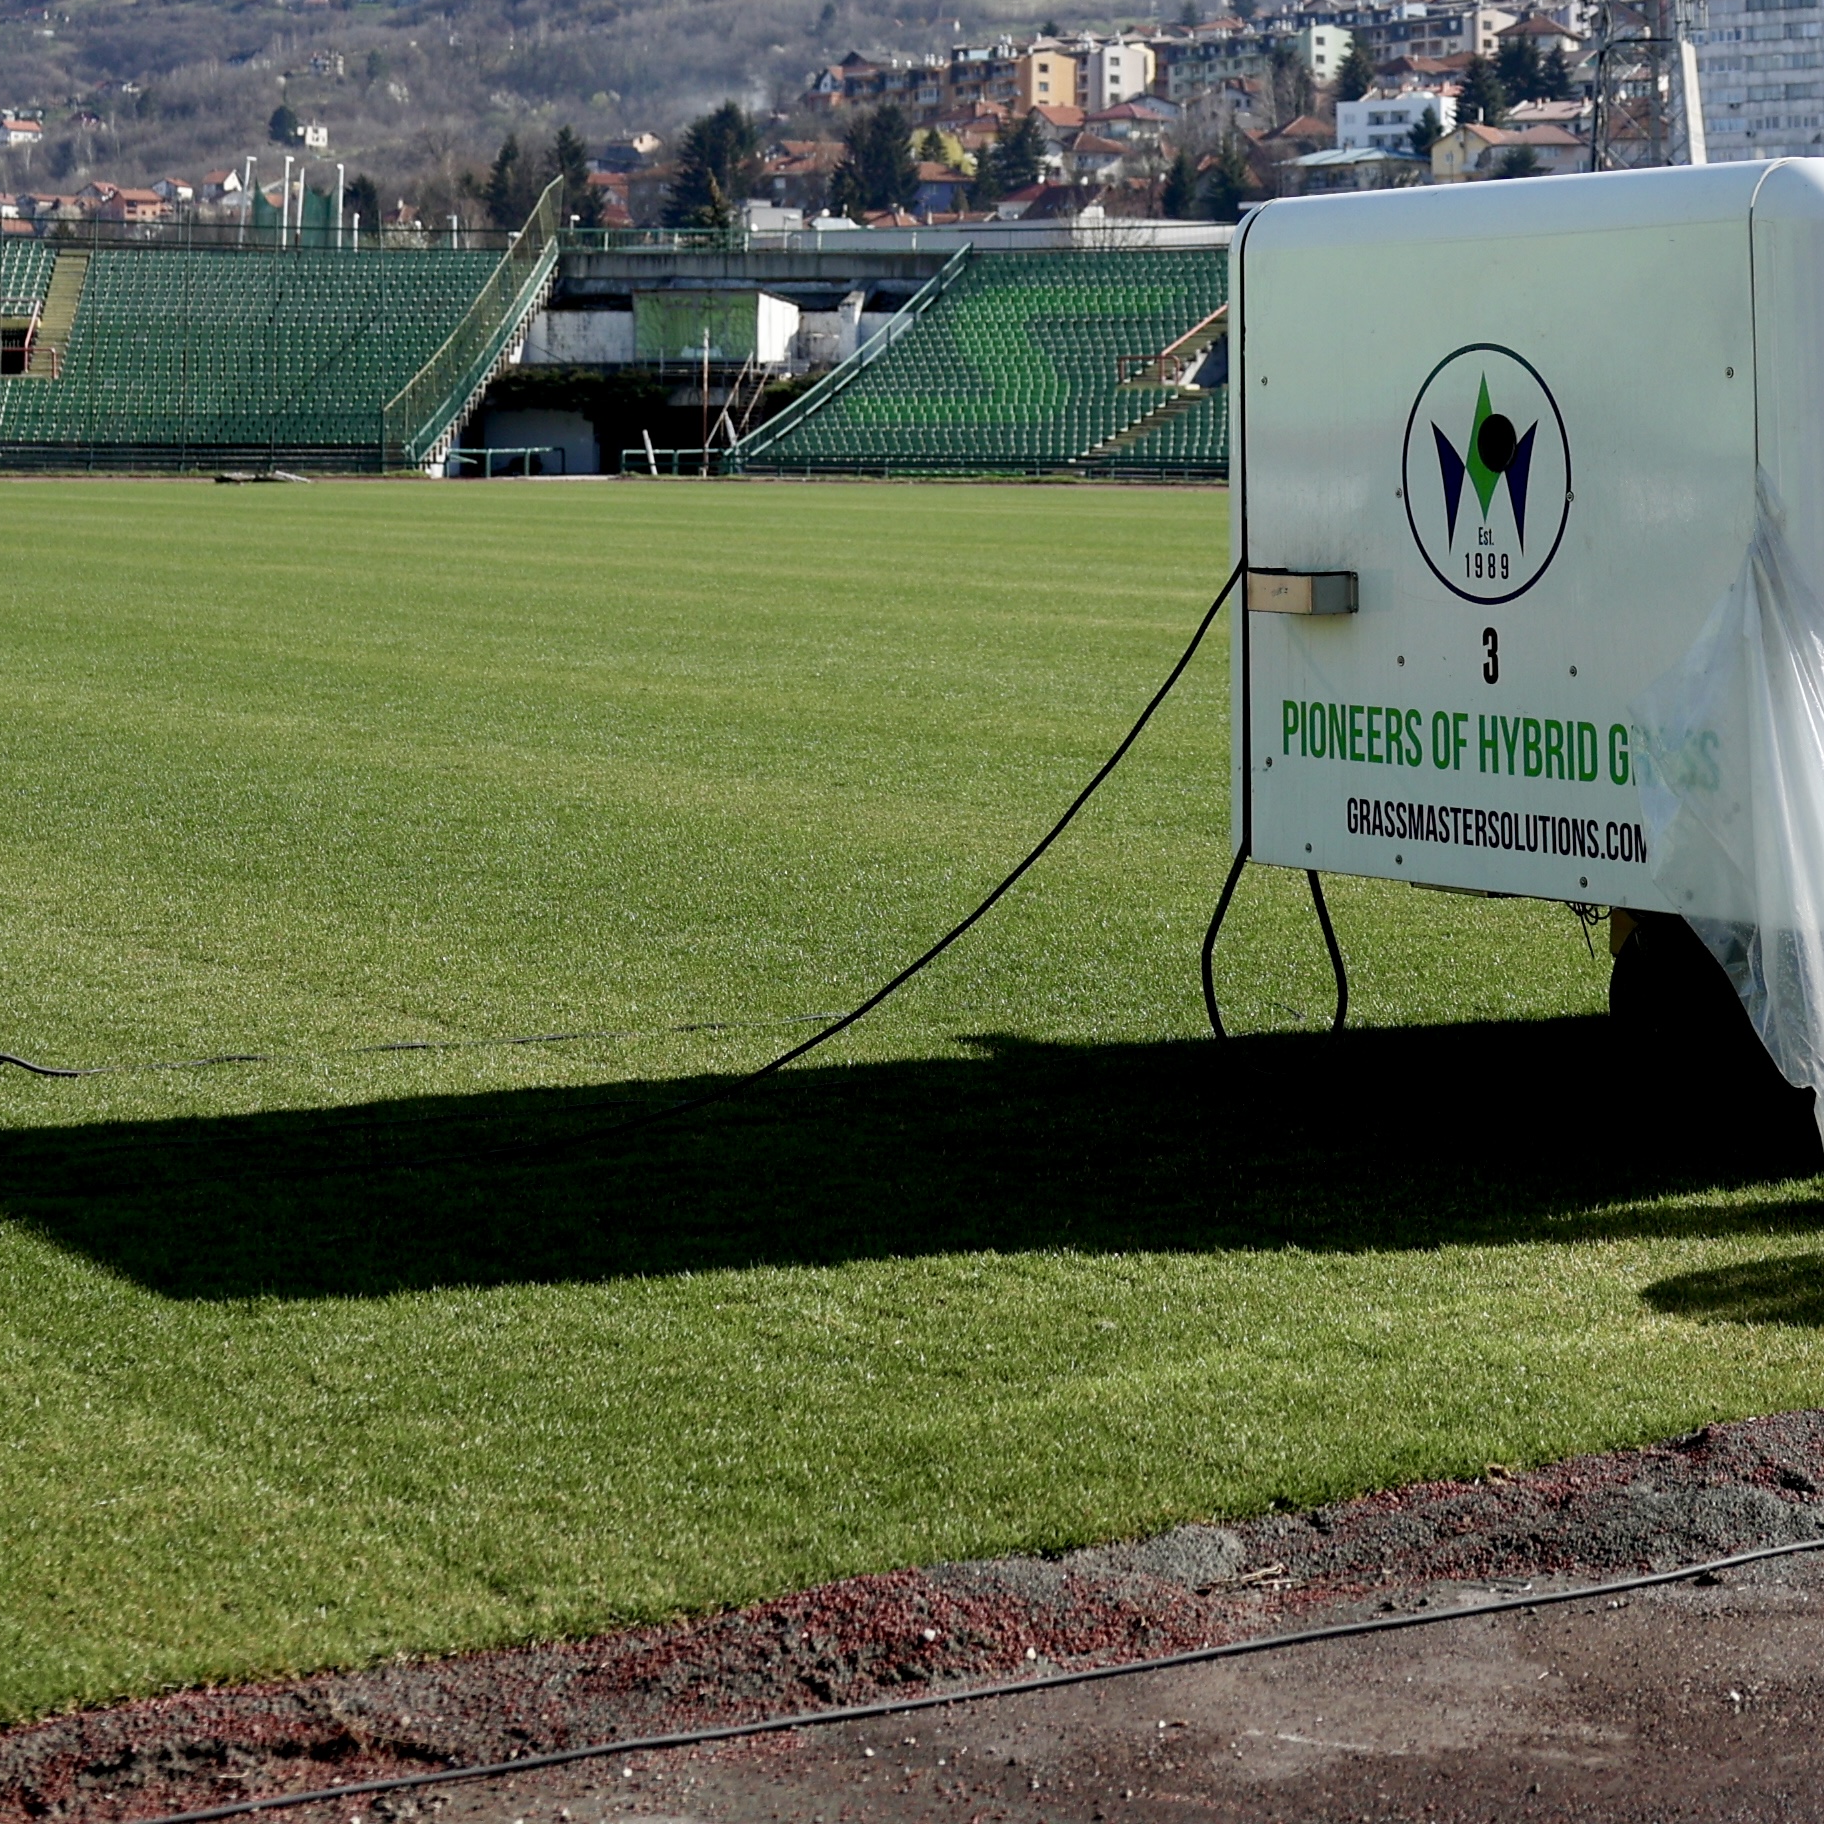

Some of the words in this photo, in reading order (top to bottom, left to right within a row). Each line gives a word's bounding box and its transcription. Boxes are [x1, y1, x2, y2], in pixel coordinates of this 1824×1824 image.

[1478, 526, 1495, 546] Est.
[1465, 552, 1509, 579] 1989
[1482, 627, 1499, 684] 3
[1282, 699, 1423, 768] PIONEERS
[1432, 710, 1469, 771] OF
[1478, 714, 1598, 782] HYBRID
[1346, 797, 1648, 864] GRASSMASTERSOLUTIONS.COM
